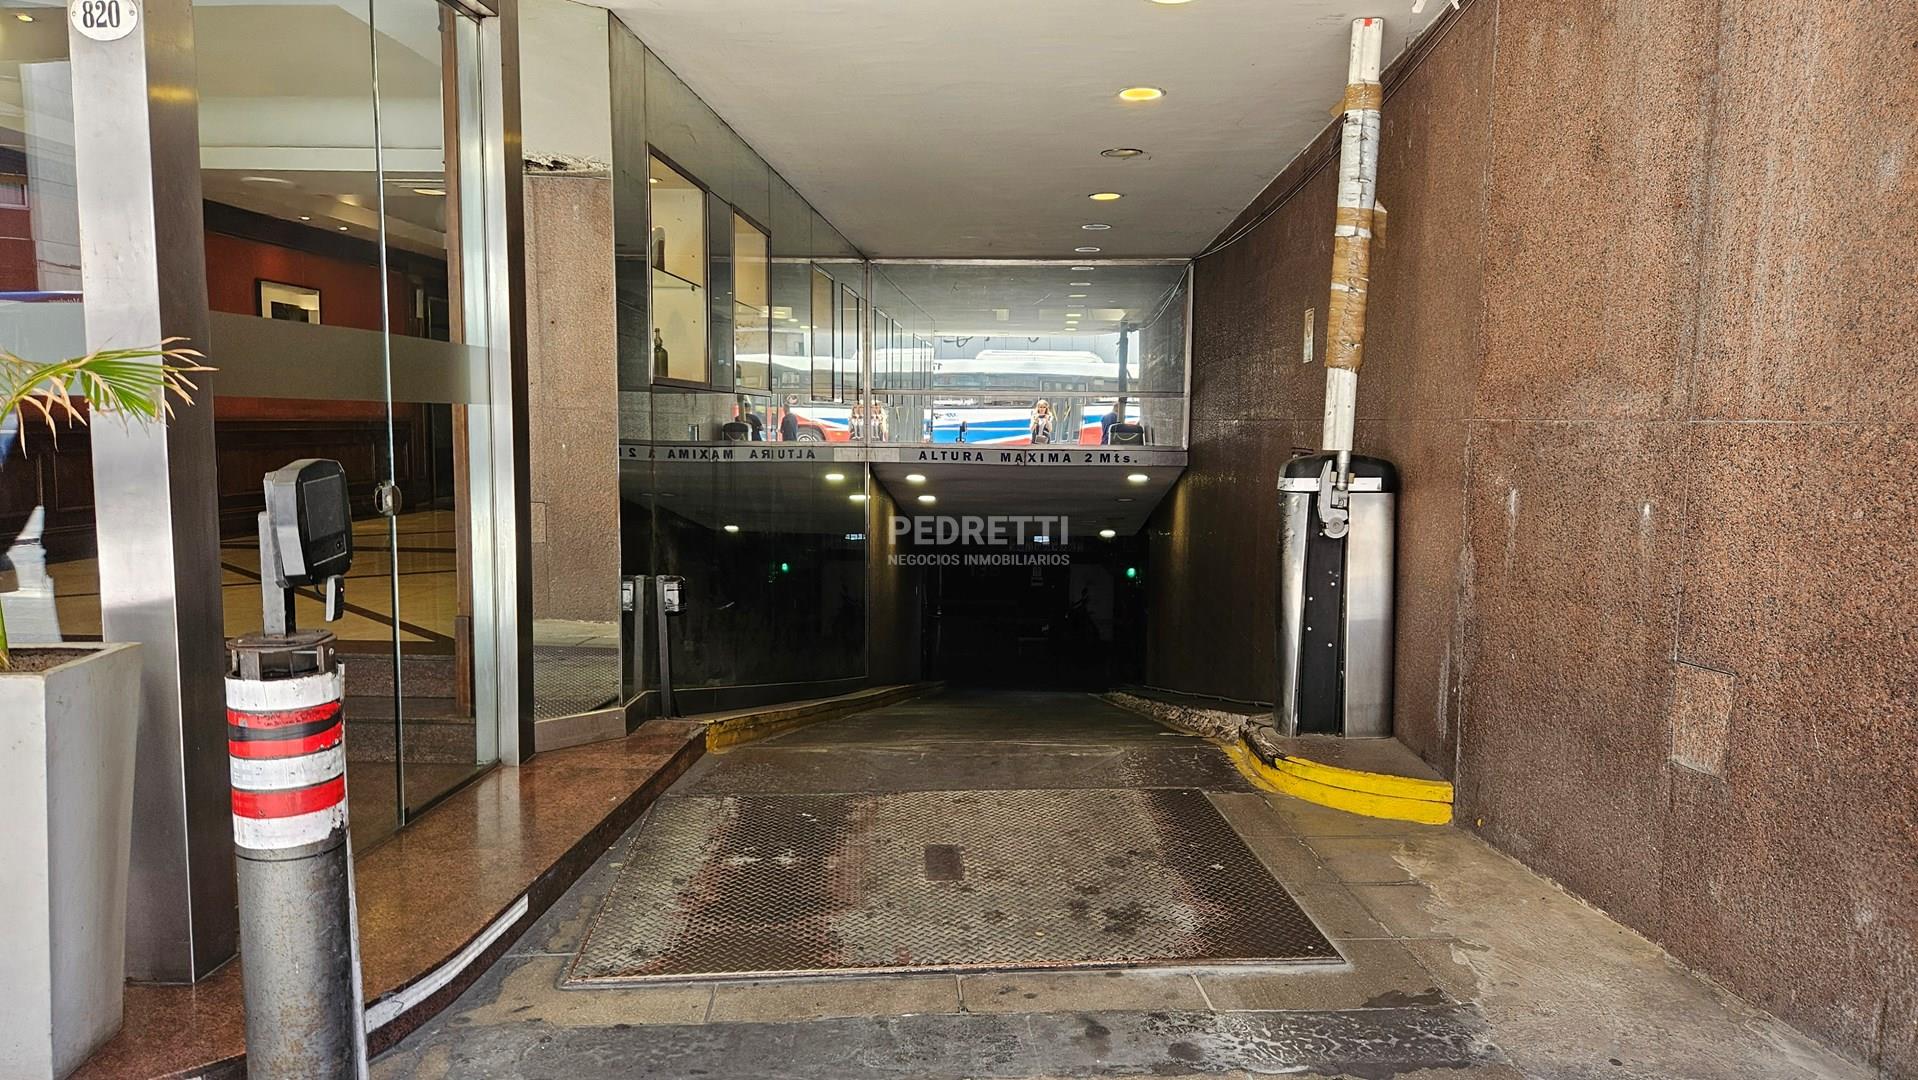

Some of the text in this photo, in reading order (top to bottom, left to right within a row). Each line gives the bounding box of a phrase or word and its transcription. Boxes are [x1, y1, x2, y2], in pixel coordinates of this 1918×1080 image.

[82, 0, 121, 28] 820
[919, 450, 1138, 464] ALTURA MAXIMA 2 Mts.
